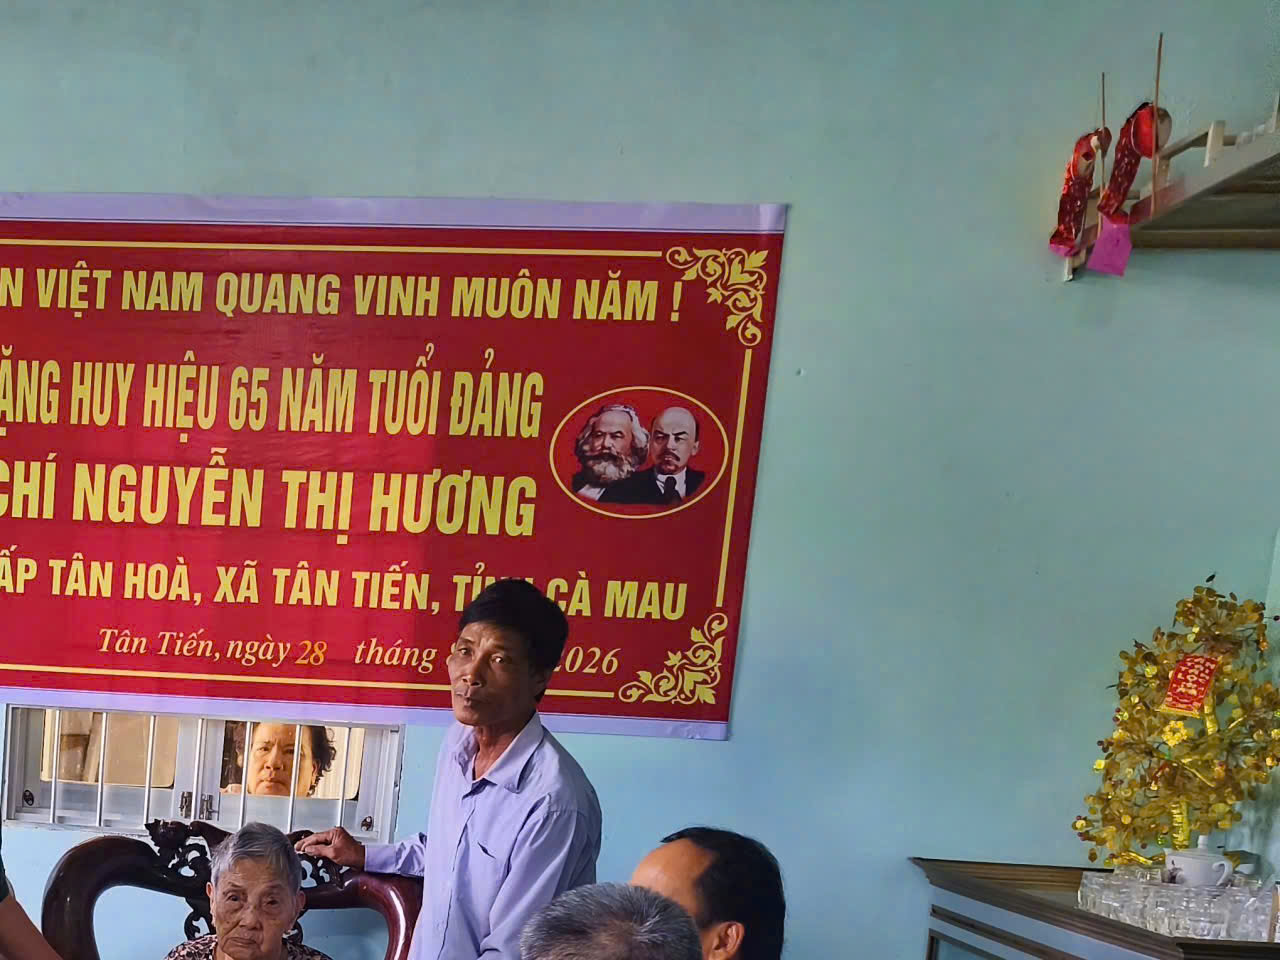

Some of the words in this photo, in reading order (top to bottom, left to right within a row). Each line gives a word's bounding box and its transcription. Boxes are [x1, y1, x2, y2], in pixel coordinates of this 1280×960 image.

[37, 261, 111, 317] VIỆT
[122, 271, 203, 311] NAM
[216, 273, 340, 317] QUANG
[355, 276, 439, 316] VINH
[452, 269, 561, 318] MUÔN
[573, 271, 658, 320] NĂM
[671, 277, 682, 321] !
[71, 362, 135, 426] HUY
[143, 351, 219, 442] HIỆU
[229, 366, 269, 431] 65
[278, 353, 357, 432] NĂM
[369, 343, 441, 435] TUỔI
[449, 348, 543, 438] ĐẢNG
[73, 448, 264, 527] NGUYỄN
[282, 470, 353, 544] THỊ
[369, 469, 536, 536] HƯƠNG
[49, 553, 112, 597] TÂN
[124, 557, 201, 605] HOÀ,
[214, 560, 258, 603] XÃ
[273, 561, 339, 606] TÂN
[352, 561, 439, 614] TIẾN,
[452, 561, 534, 612] TỈ
[547, 571, 591, 616] CÀ
[604, 581, 687, 620] MAU
[100, 629, 146, 653] Tân
[158, 629, 219, 661] Tiến,
[227, 634, 290, 667] ngày
[296, 641, 326, 665] 28
[355, 638, 438, 673] tháng
[554, 647, 620, 674] 026
